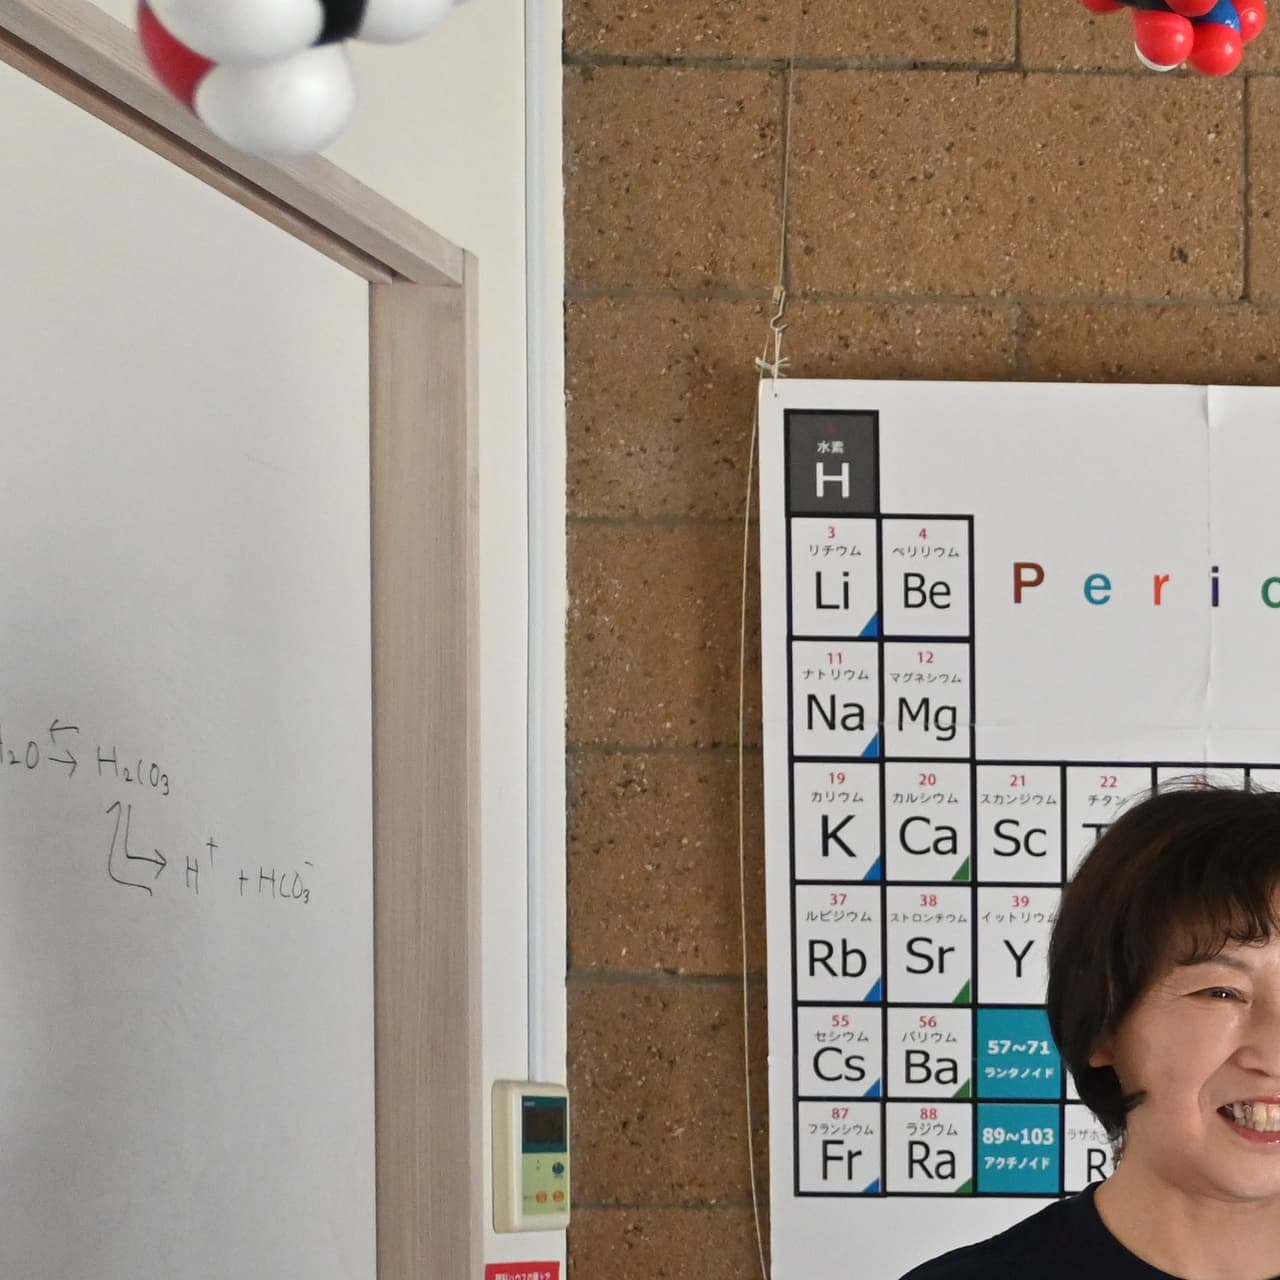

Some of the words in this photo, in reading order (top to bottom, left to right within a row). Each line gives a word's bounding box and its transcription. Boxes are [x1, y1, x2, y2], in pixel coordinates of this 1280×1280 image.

[817, 441, 844, 454] 水素
[816, 462, 849, 497] H
[829, 527, 835, 538] 3
[810, 545, 861, 556] リチウム
[816, 571, 849, 609] Li
[904, 573, 950, 609] Be
[804, 669, 869, 680] ナトリウム
[828, 653, 842, 664] 11
[891, 672, 961, 683] マグネシウム
[808, 694, 864, 731] Na
[899, 697, 956, 741] Mg
[830, 773, 845, 784] 19
[893, 793, 958, 803] カルシウム
[822, 815, 856, 857] K
[900, 816, 957, 855] Ca
[994, 819, 1046, 857] Sc
[809, 939, 866, 977] Rb
[832, 1015, 849, 1027] 55
[813, 1047, 865, 1081] Cs
